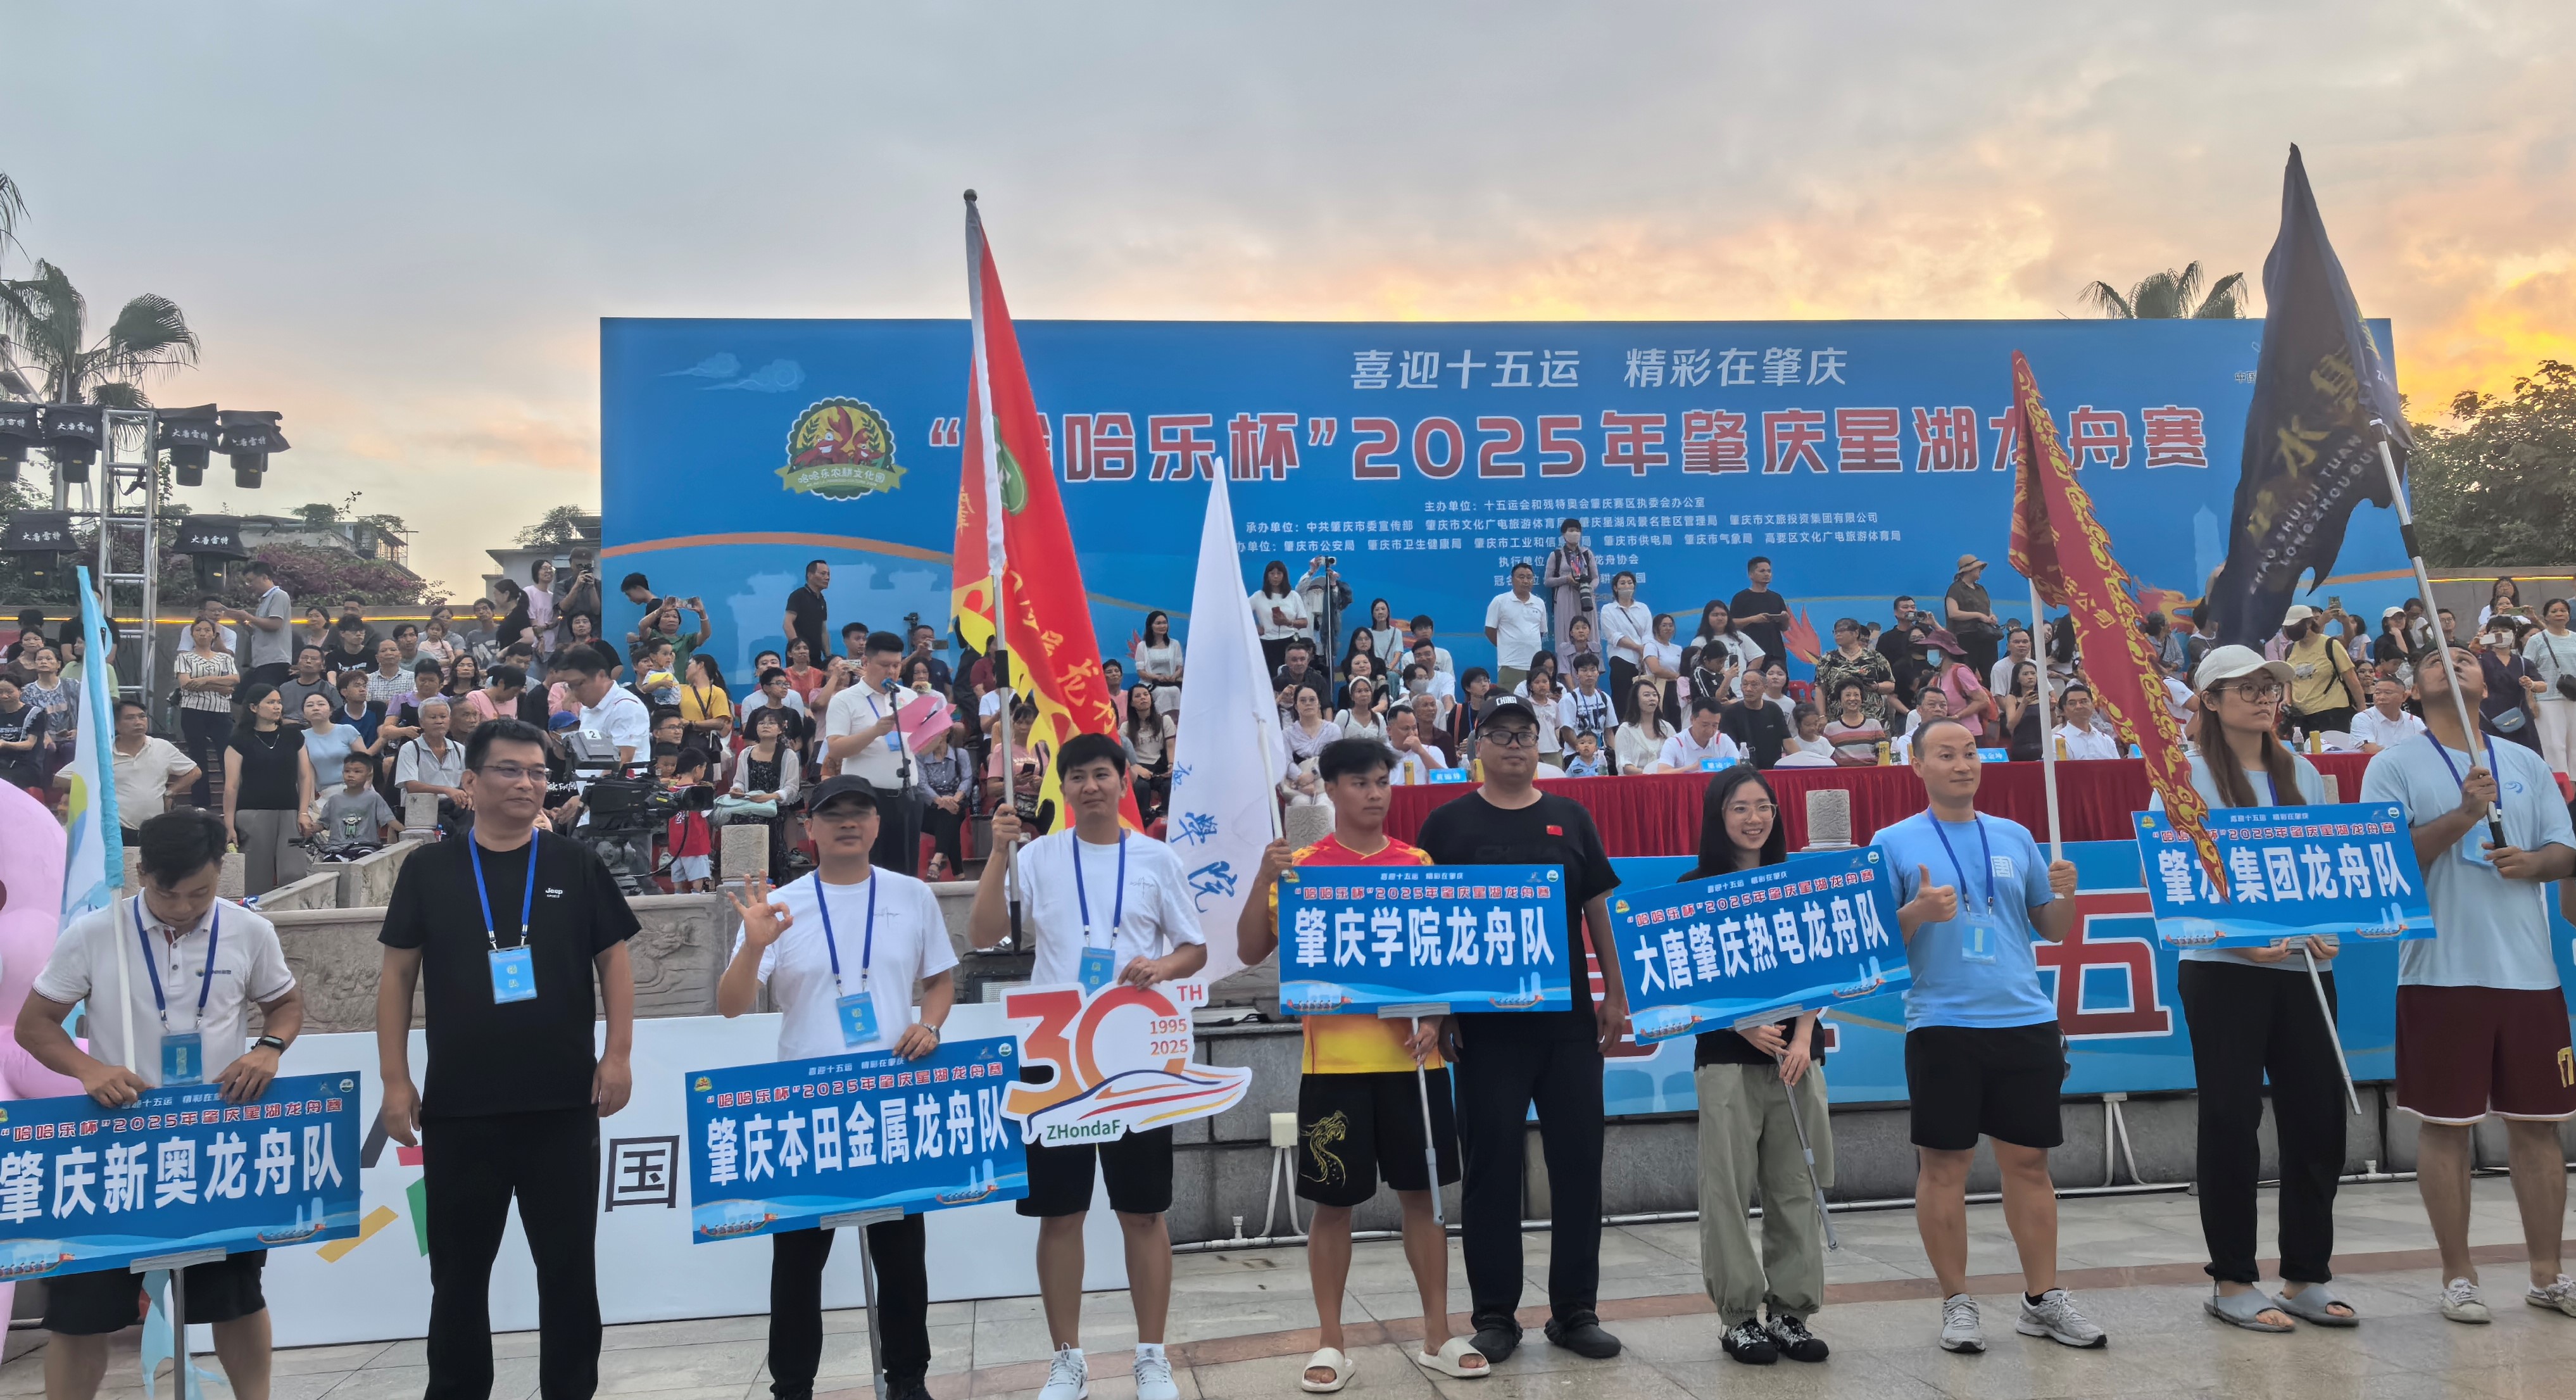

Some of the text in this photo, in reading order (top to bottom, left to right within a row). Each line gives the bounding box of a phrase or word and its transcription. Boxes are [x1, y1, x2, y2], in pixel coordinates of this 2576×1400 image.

[1351, 346, 1849, 390] 喜迎十五运 精彩在肇庆
[929, 405, 2208, 483] “哈乐杯”2025年肇庆星湖舟赛
[1495, 696, 1518, 706] CHINA
[589, 730, 597, 738] 2
[2152, 821, 2396, 843] “哈哈杯”2025年肇庆星湖龙舟赛
[1295, 906, 1555, 968] 肇庆学院龙舟队
[1633, 889, 1890, 997] 大唐肇庆热电龙舟队
[1177, 984, 1203, 1002] TH
[1150, 1018, 1188, 1035] 1995
[1150, 1038, 1189, 1057] 2025
[707, 1083, 1010, 1187] 肇庆本田金属龙舟队
[1046, 1119, 1121, 1140] ZHondaF
[0, 1122, 344, 1224] 肇庆新奥龙舟队
[605, 1135, 680, 1212] 国
